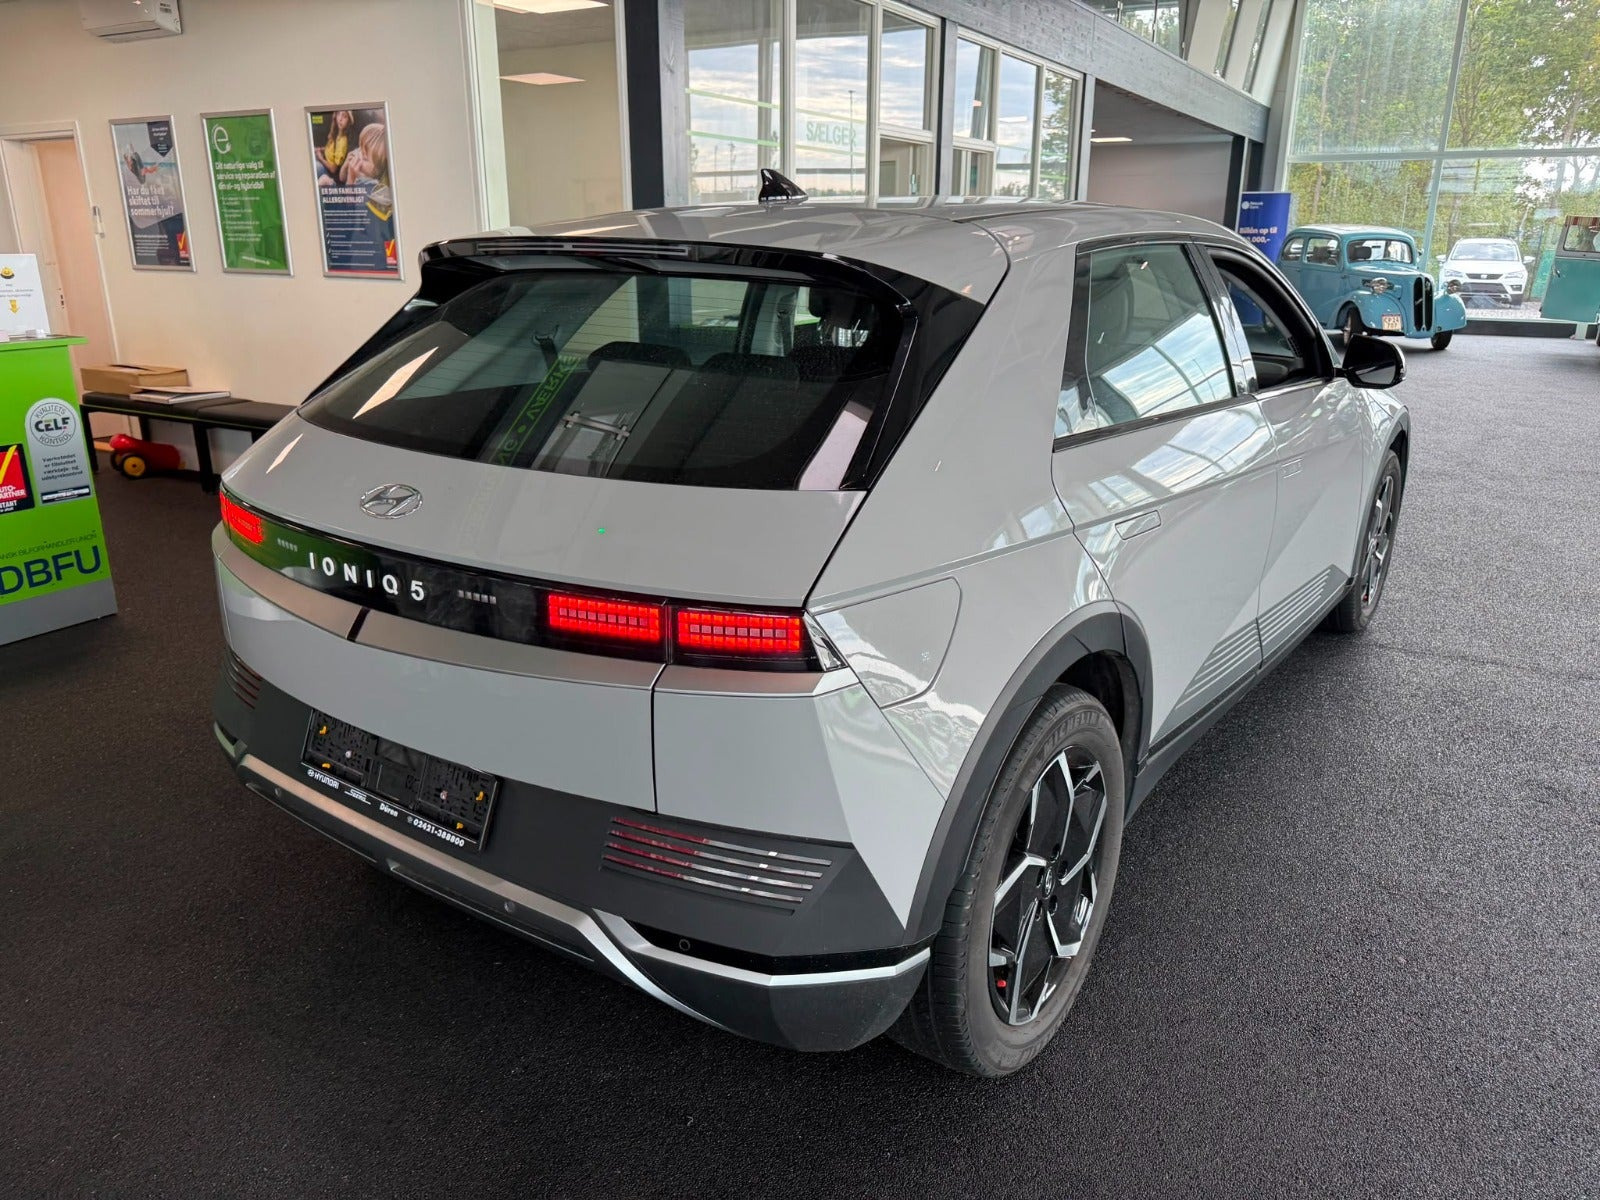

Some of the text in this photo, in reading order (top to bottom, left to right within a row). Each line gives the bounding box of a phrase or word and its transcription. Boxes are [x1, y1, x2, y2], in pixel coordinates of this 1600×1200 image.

[806, 120, 857, 148] SÆLGER
[127, 185, 140, 196] Har
[140, 184, 150, 195] du
[129, 195, 160, 206] skiftet til
[130, 204, 174, 218] sommerhjul?
[1259, 228, 1269, 236] op
[1270, 226, 1278, 234] til
[34, 404, 67, 418] KVALITETS
[34, 416, 70, 433] CELF
[39, 432, 72, 445] KONTROL
[0, 545, 101, 596] DBFU
[309, 552, 425, 601] IONIQ 5
[313, 771, 465, 847] HYUNDAI Düren 02421-388800
